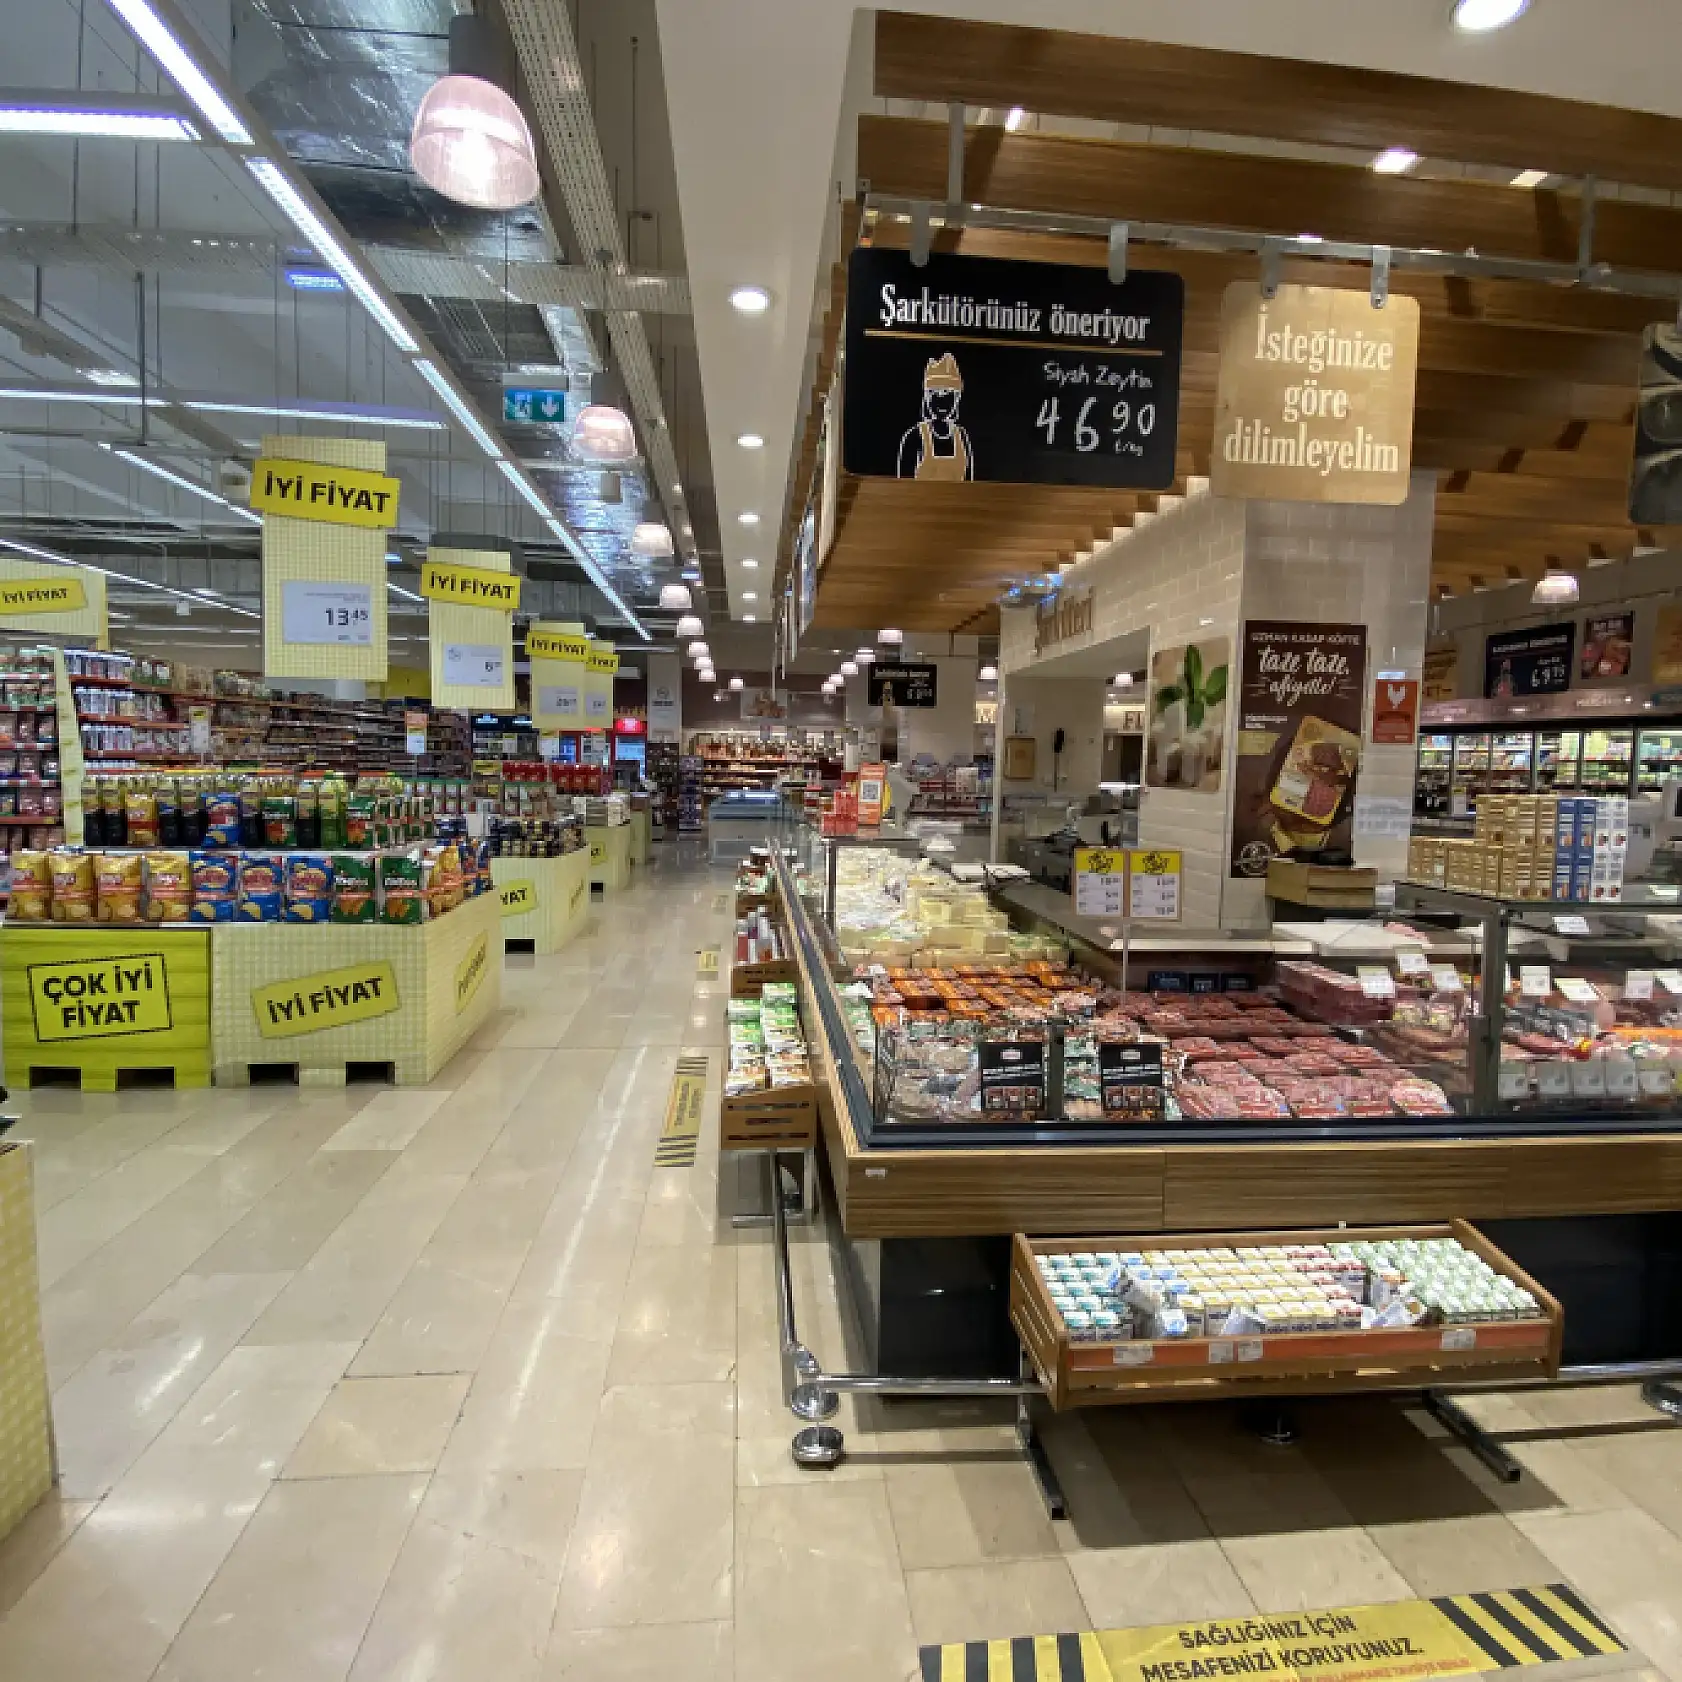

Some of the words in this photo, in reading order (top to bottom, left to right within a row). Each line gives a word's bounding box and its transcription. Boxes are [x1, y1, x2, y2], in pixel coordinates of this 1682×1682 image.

[880, 283, 1042, 331] Şarkütörünüz
[1049, 304, 1151, 344] öneriyor
[1255, 302, 1394, 374] İsteğinize
[1282, 379, 1350, 422] göre
[1224, 416, 1399, 476] dilimleyelim
[265, 470, 303, 501] İYİ
[309, 480, 391, 513] FİYAT
[429, 571, 457, 592] İYİ
[460, 578, 515, 600] FİYAT
[43, 973, 108, 1006] ÇOK
[113, 961, 153, 993] İYİ
[267, 993, 307, 1023] İYİ
[308, 976, 383, 1014] FİYAT
[61, 1000, 140, 1028] FİYAT
